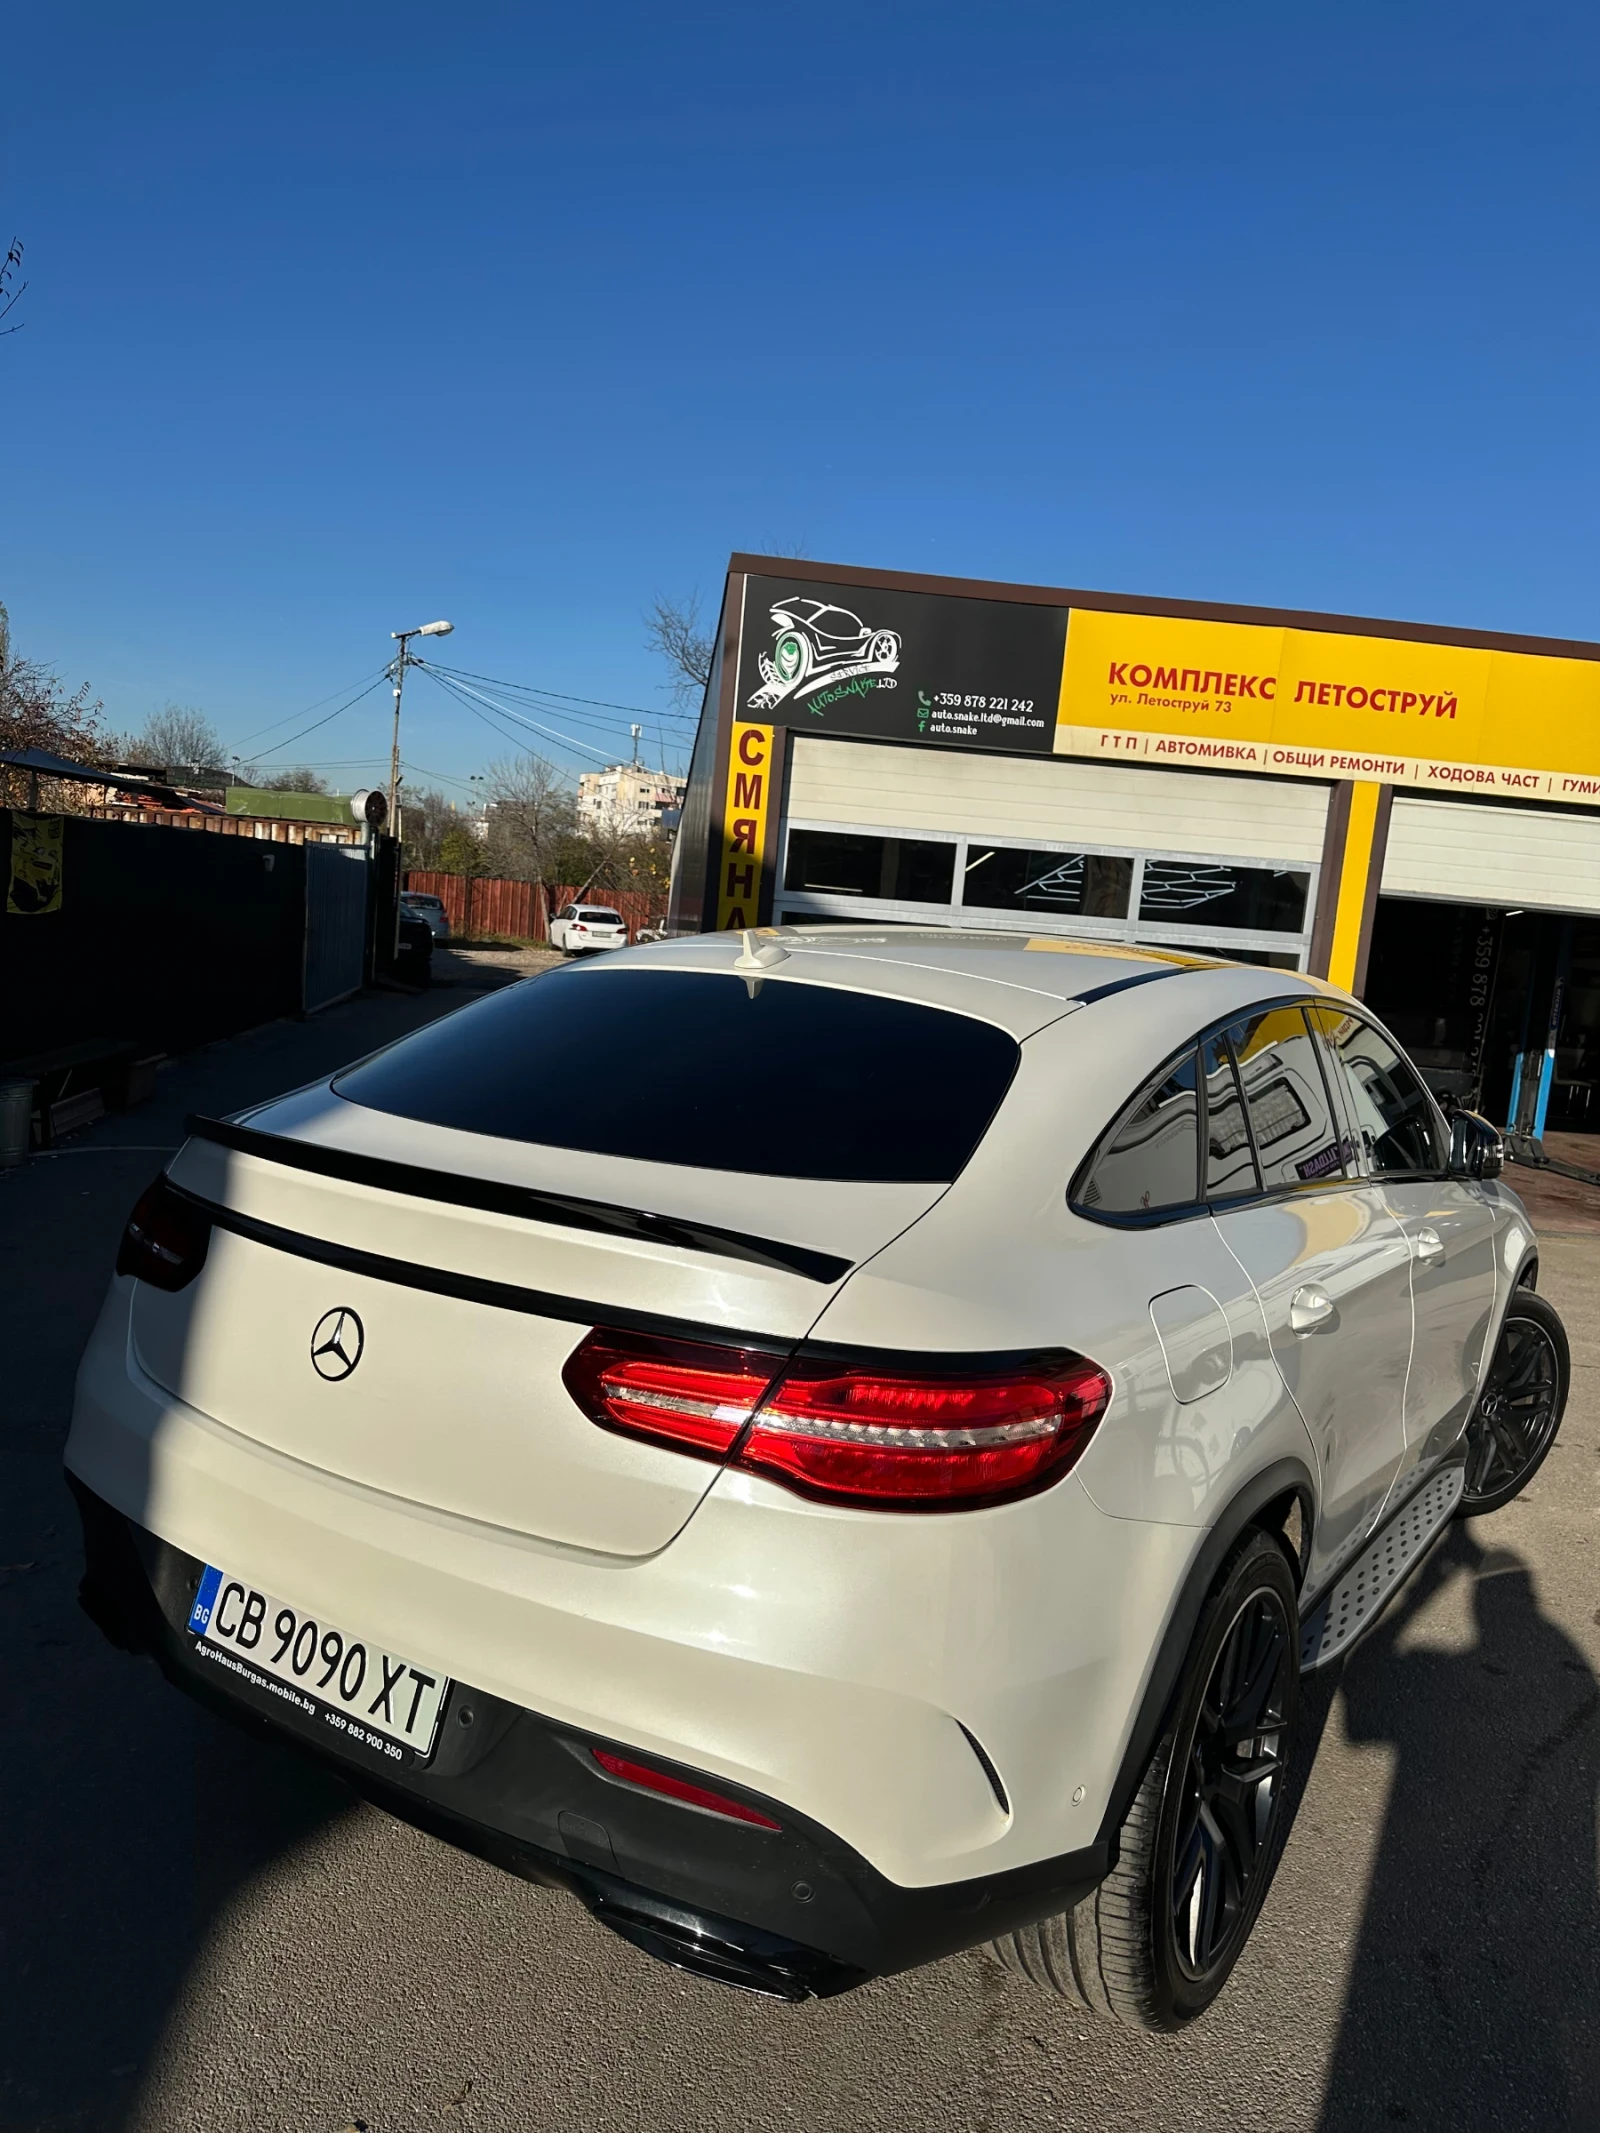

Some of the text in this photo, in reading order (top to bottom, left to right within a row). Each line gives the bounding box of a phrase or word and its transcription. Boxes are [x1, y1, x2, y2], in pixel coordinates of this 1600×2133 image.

[830, 665, 871, 681] SERVICE
[1108, 662, 1458, 719] КОМПЛЕКС ЛЕТОСТРУЙ
[933, 692, 1034, 712] +359 878 221 242
[1110, 693, 1232, 714] ул. Летоструй 73
[930, 722, 978, 735] auto.snake
[931, 709, 1045, 728] auto.snake.ltd@gmail.com
[1155, 739, 1257, 761] АВТОМИВКА
[1272, 750, 1325, 769] ОБЩИ
[1330, 756, 1405, 775] РЕМОНТИ
[1428, 766, 1495, 784] ХОДОВА
[1501, 773, 1540, 788] ЧАСТ
[193, 1604, 211, 1624] BG
[215, 1582, 436, 1734] CB 9090 XT
[195, 1640, 403, 1760] AgroHausBurgas.mobile.bg +359 882 900 350
